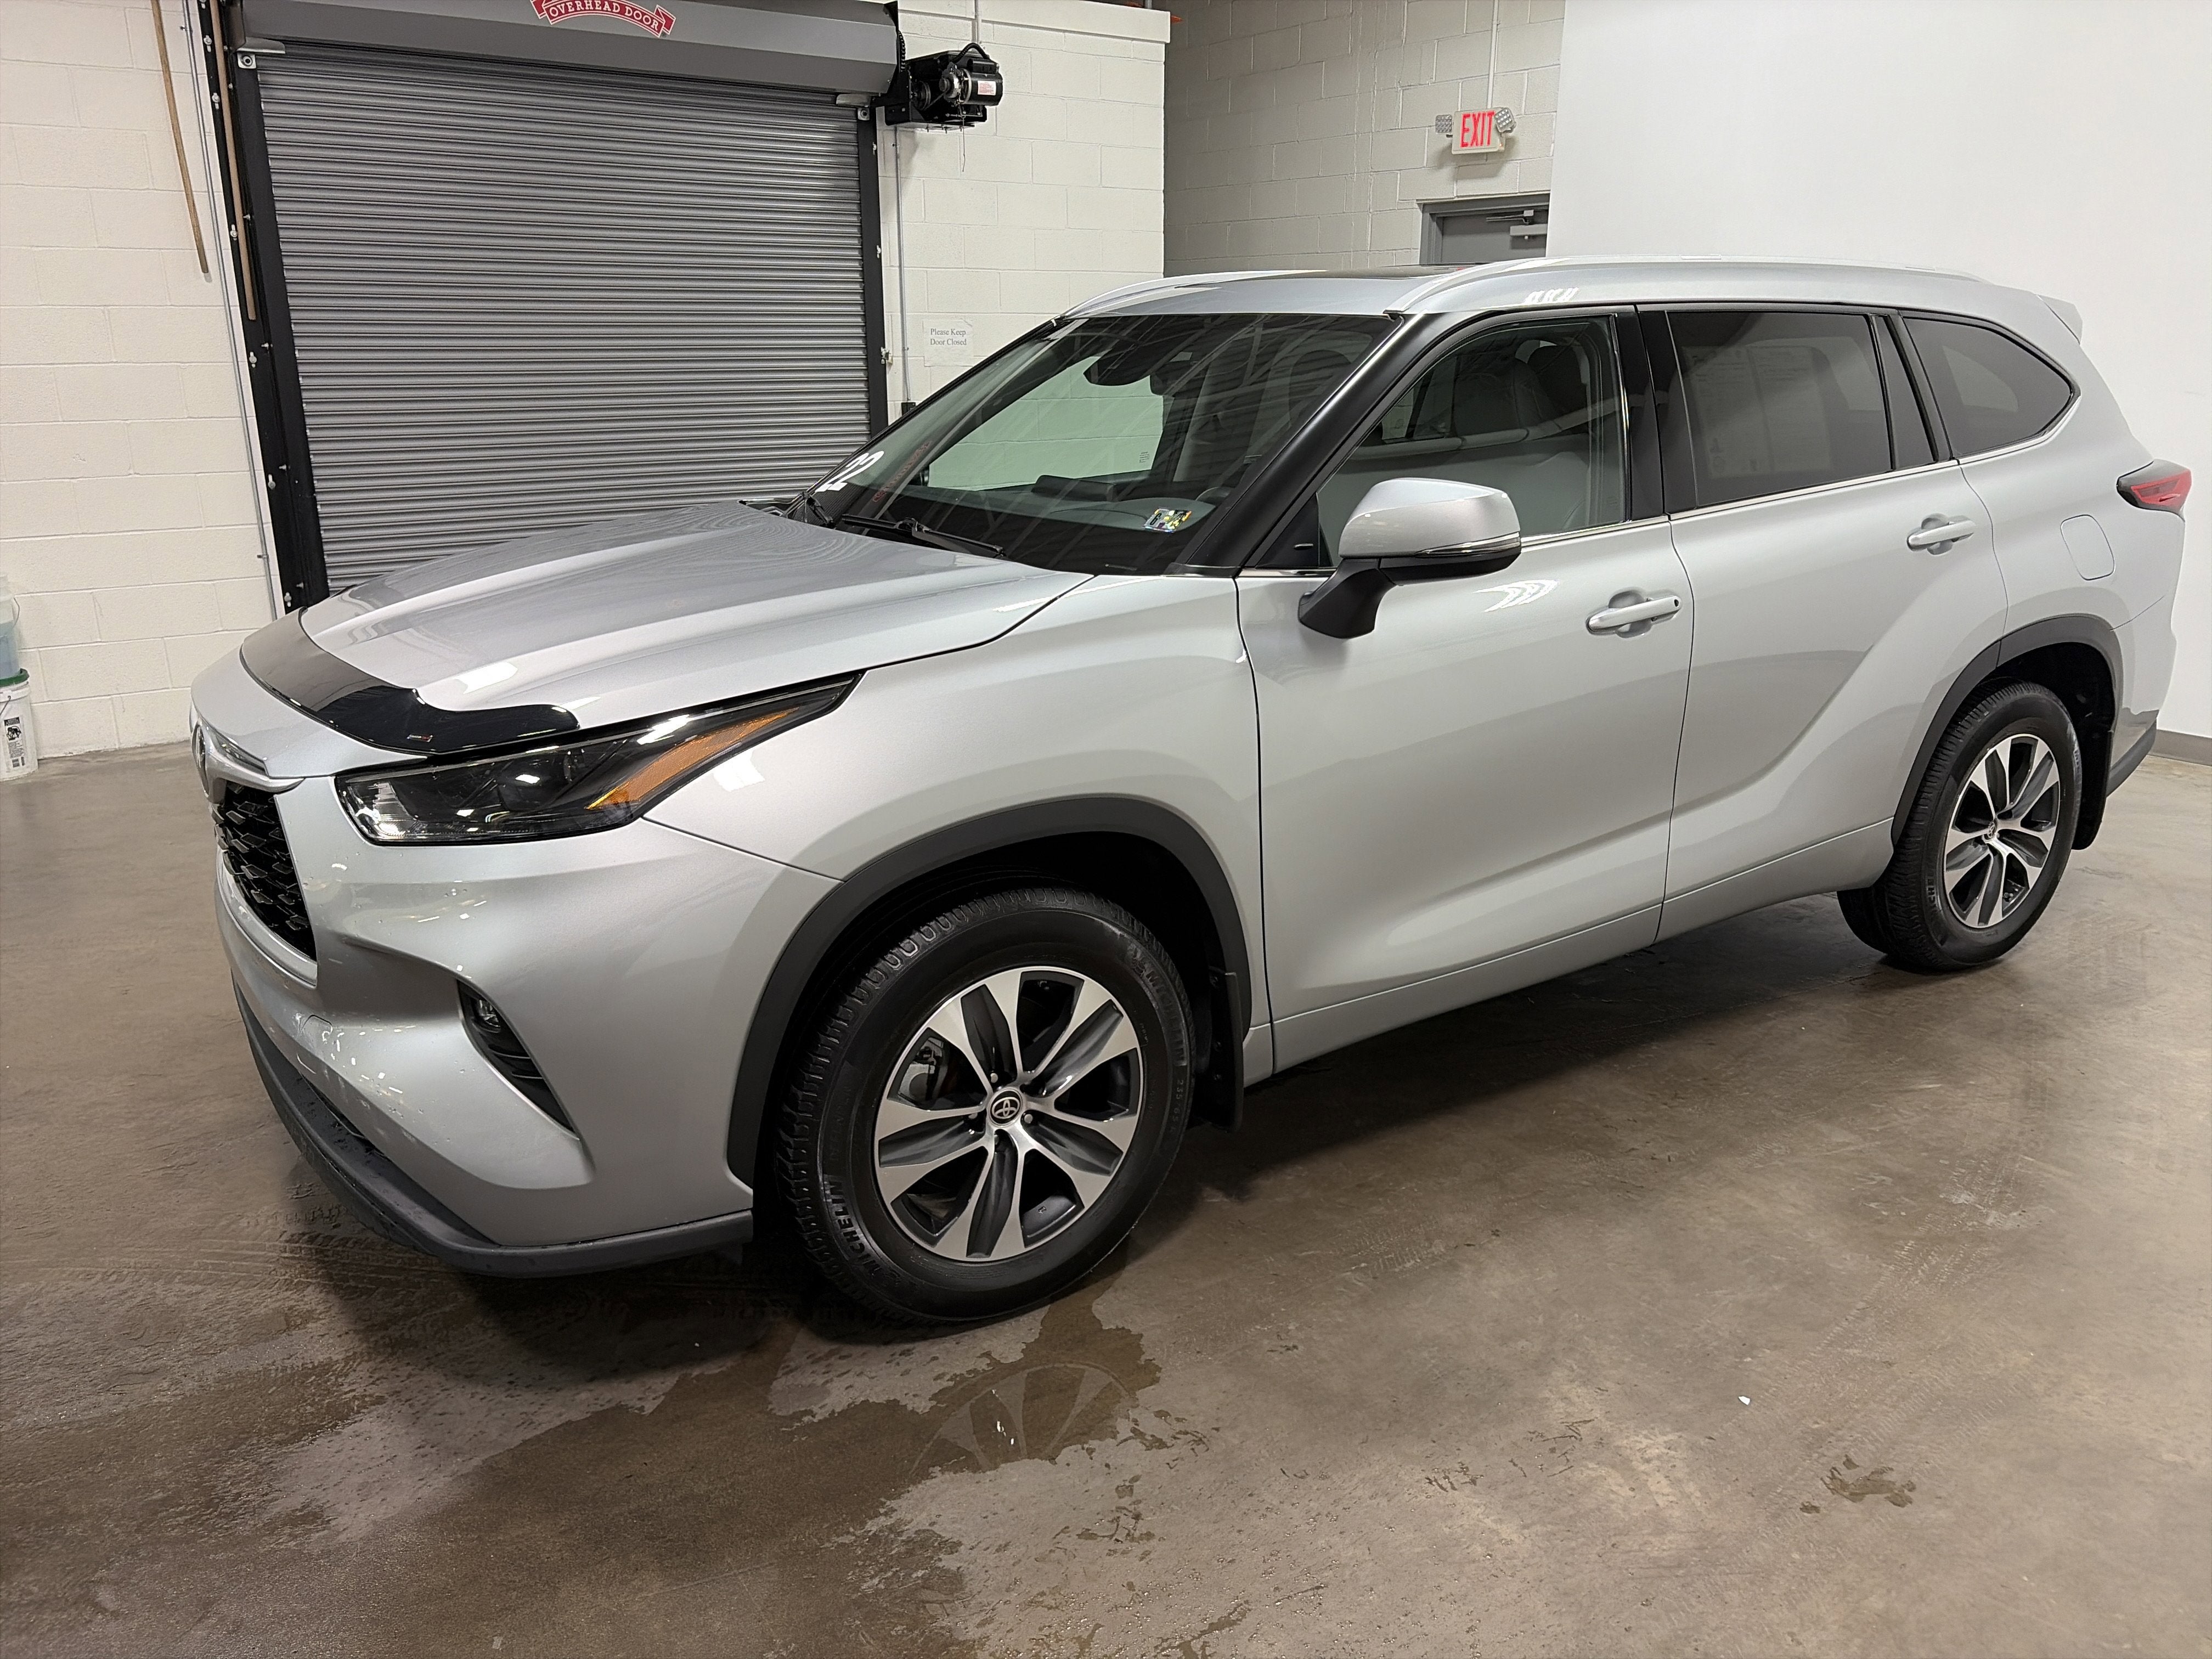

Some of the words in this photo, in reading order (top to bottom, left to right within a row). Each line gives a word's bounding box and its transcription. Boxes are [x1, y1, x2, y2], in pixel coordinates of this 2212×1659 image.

[549, 0, 620, 17] OVERHEAD
[625, 6, 659, 31] DOOR
[1460, 111, 1496, 148] EXIT
[951, 328, 966, 337] Keep
[815, 450, 884, 493] 22
[828, 1181, 883, 1276] MICHELIN
